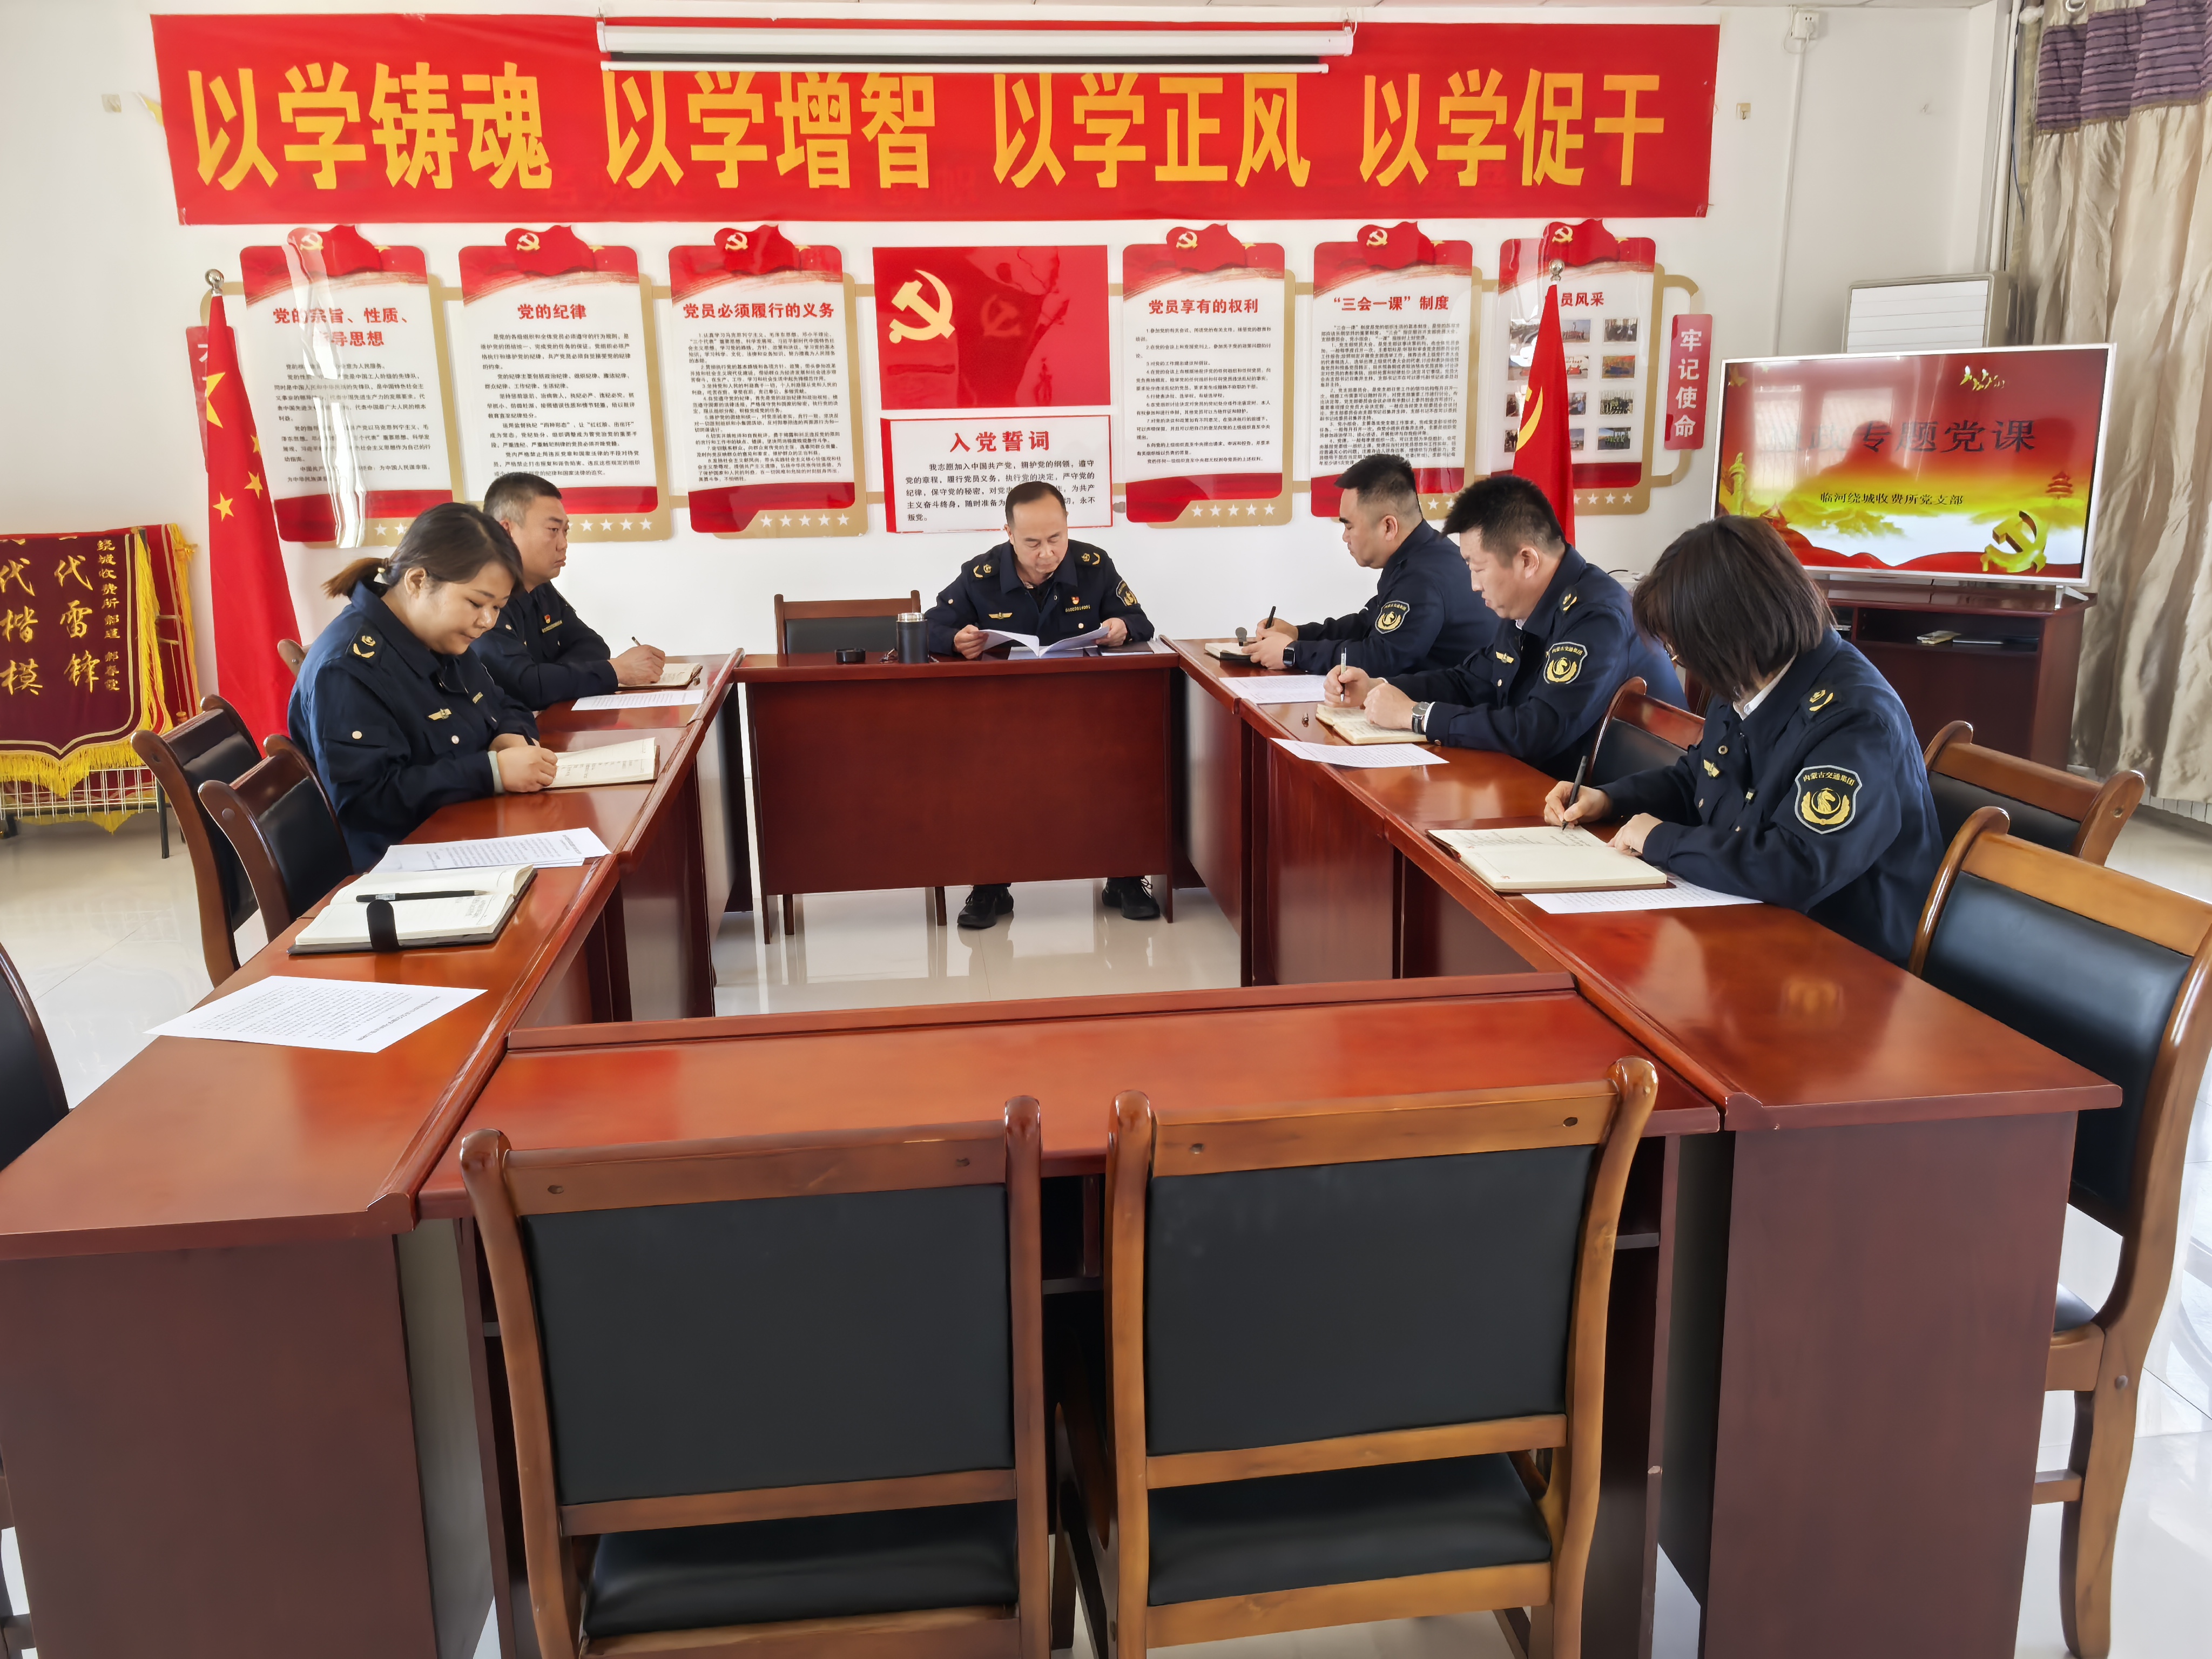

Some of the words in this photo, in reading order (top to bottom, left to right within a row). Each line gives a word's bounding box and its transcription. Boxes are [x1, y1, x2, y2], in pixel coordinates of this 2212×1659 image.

[188, 62, 552, 190] 以学铸魂
[602, 71, 936, 188] 以学增智
[992, 73, 1311, 187] 以学正风
[1360, 68, 1664, 186] 以学促干
[1149, 298, 1259, 314] 党员享有的权利
[1561, 292, 1604, 307] 员风采
[517, 304, 587, 320] 党的纪律
[683, 302, 834, 319] 党员必须履行的义务
[316, 331, 385, 347] 导思想
[1674, 328, 1702, 438] 牢记使命
[949, 430, 1050, 453] 入党誓词
[1820, 491, 1964, 505] 临河绕城收费所党支部
[0, 538, 43, 696] 代楷模
[54, 536, 100, 694] 代雷锋
